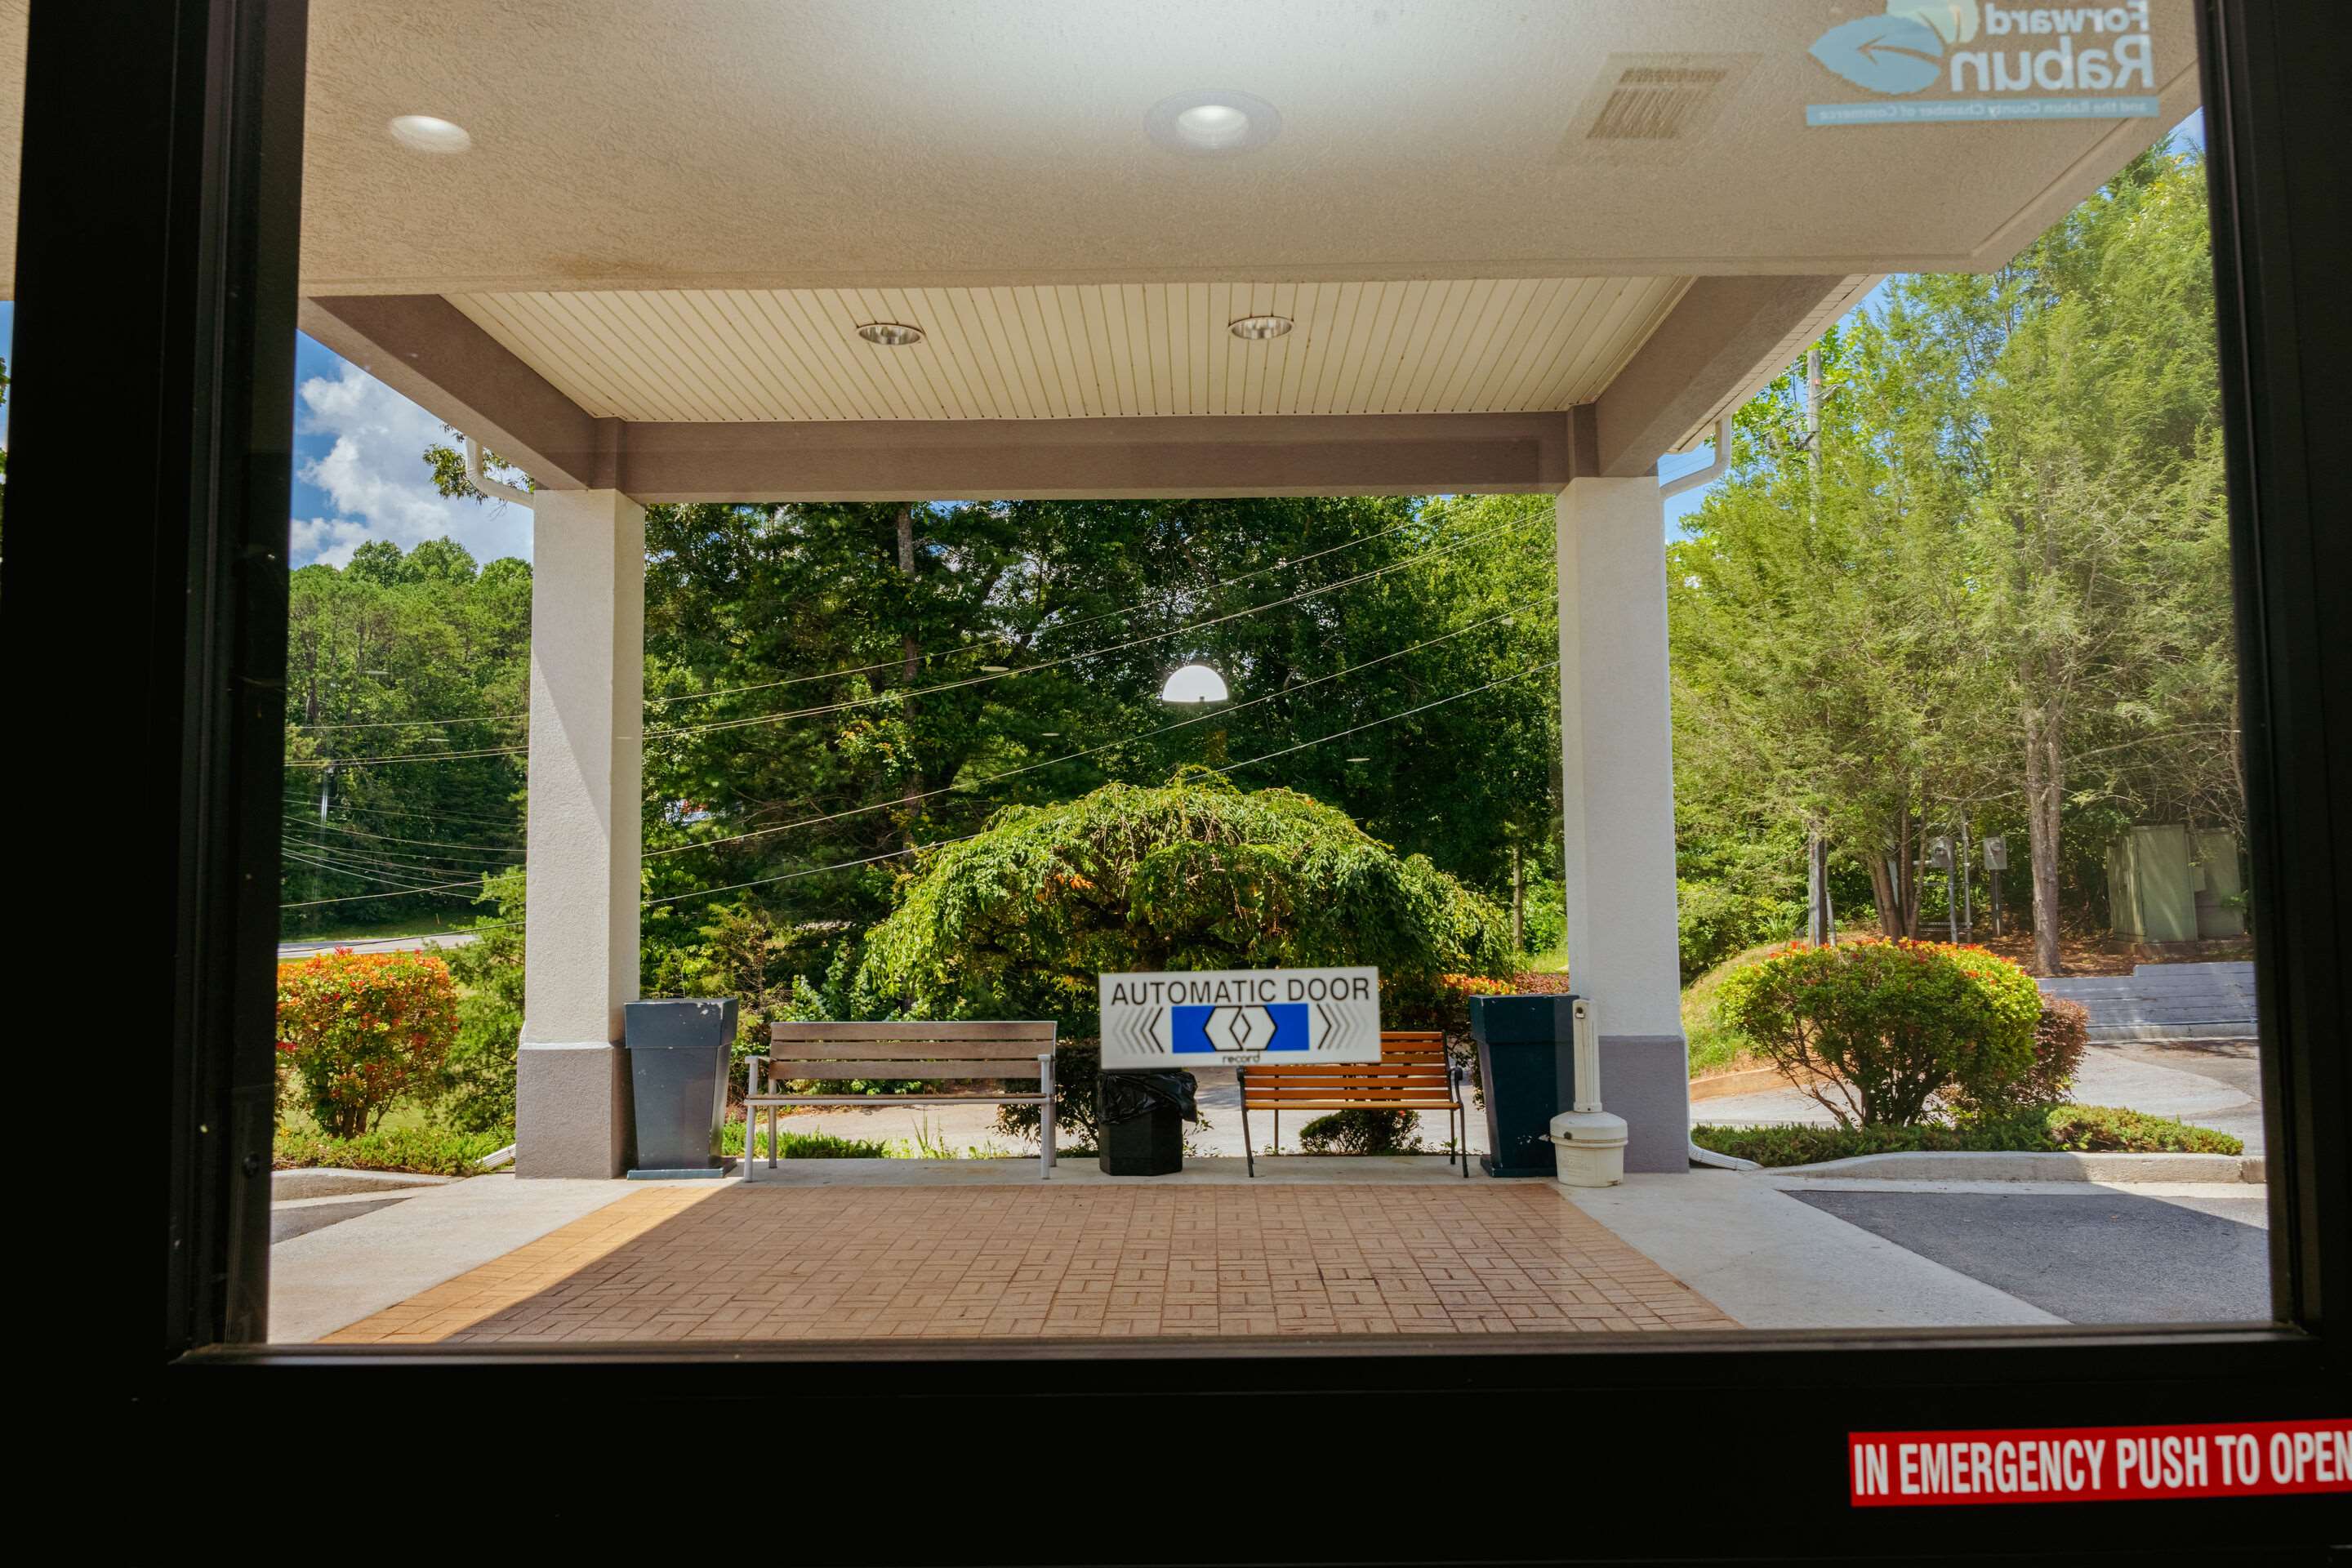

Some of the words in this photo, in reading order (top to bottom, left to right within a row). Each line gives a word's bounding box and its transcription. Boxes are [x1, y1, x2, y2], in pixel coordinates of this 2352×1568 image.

[1111, 979, 1276, 1005] AUTOMATIC
[1288, 978, 1370, 1002] DOOR
[1223, 1050, 1260, 1064] record
[1855, 1444, 1888, 1495] IN
[1899, 1439, 2105, 1494] EMERGENCY
[2117, 1437, 2208, 1489] PUSH
[2215, 1433, 2261, 1486] TO
[2270, 1430, 2352, 1484] OPEN
